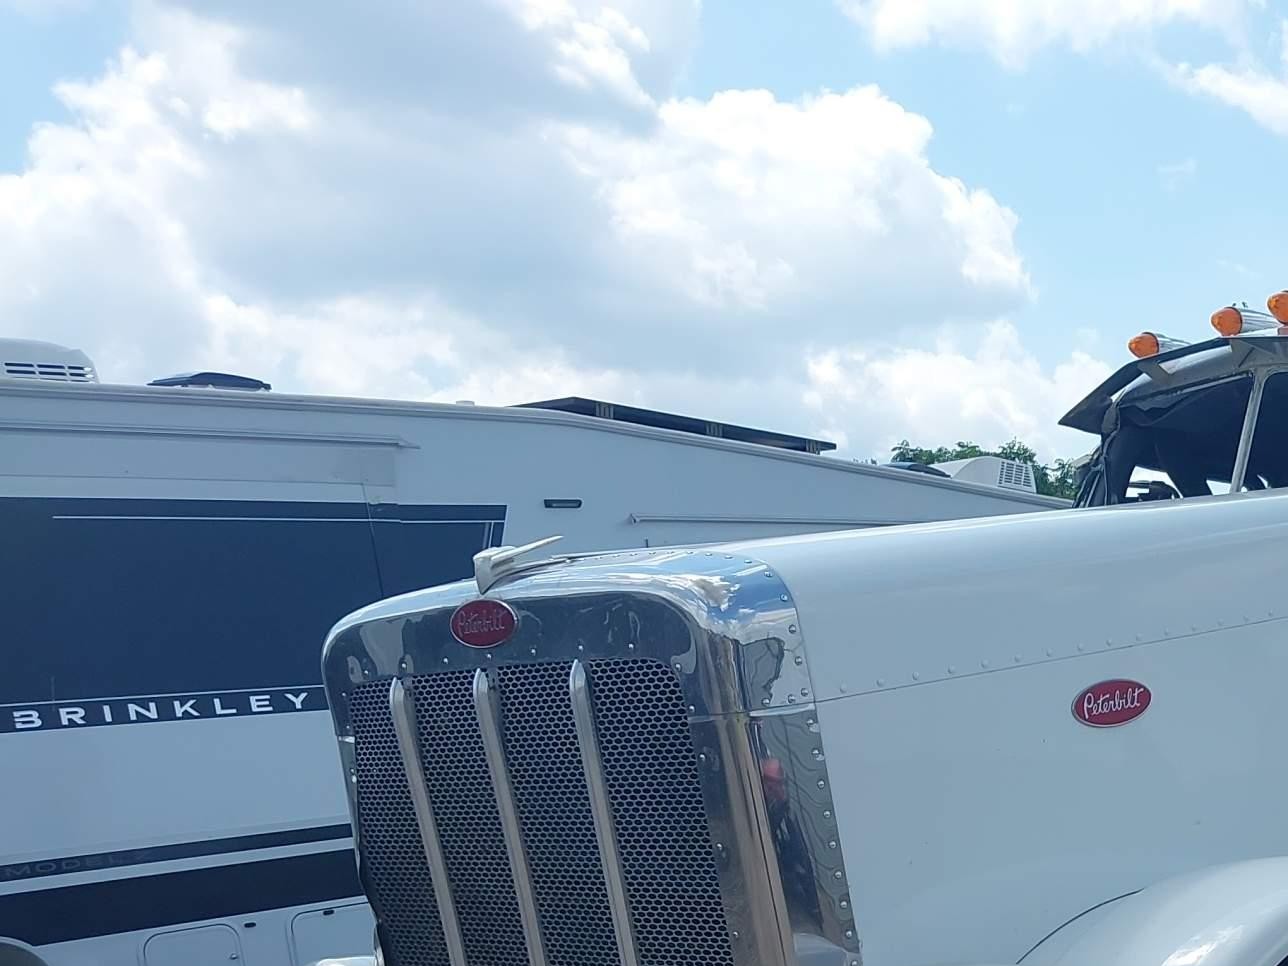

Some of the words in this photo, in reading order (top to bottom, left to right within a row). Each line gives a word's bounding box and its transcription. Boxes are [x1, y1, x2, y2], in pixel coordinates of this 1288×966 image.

[12, 692, 308, 729] BRINKLEY
[1083, 687, 1144, 720] Peterbilt
[4, 853, 119, 876] MODEL
